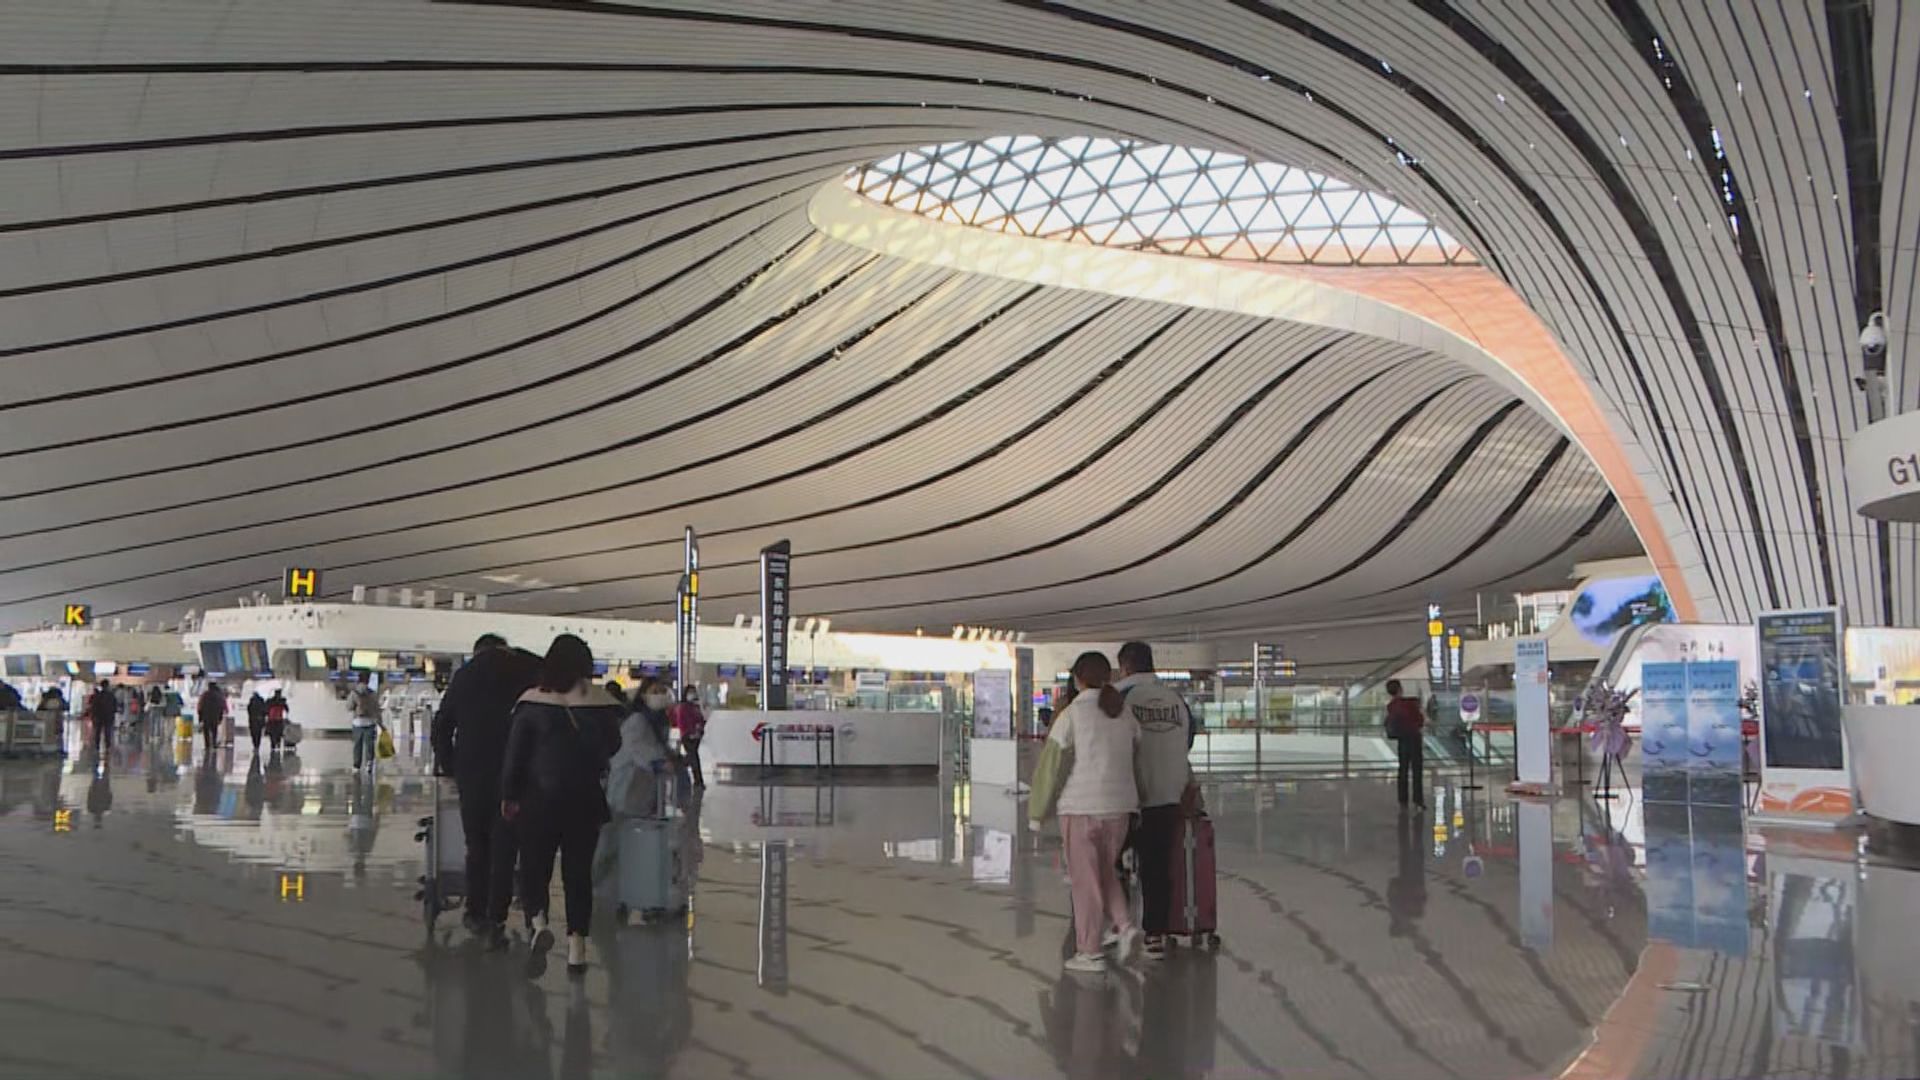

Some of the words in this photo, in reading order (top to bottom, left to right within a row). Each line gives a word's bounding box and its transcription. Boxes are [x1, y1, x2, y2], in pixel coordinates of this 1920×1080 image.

[1888, 454, 1920, 485] G1
[290, 569, 315, 596] H
[66, 605, 84, 626] K
